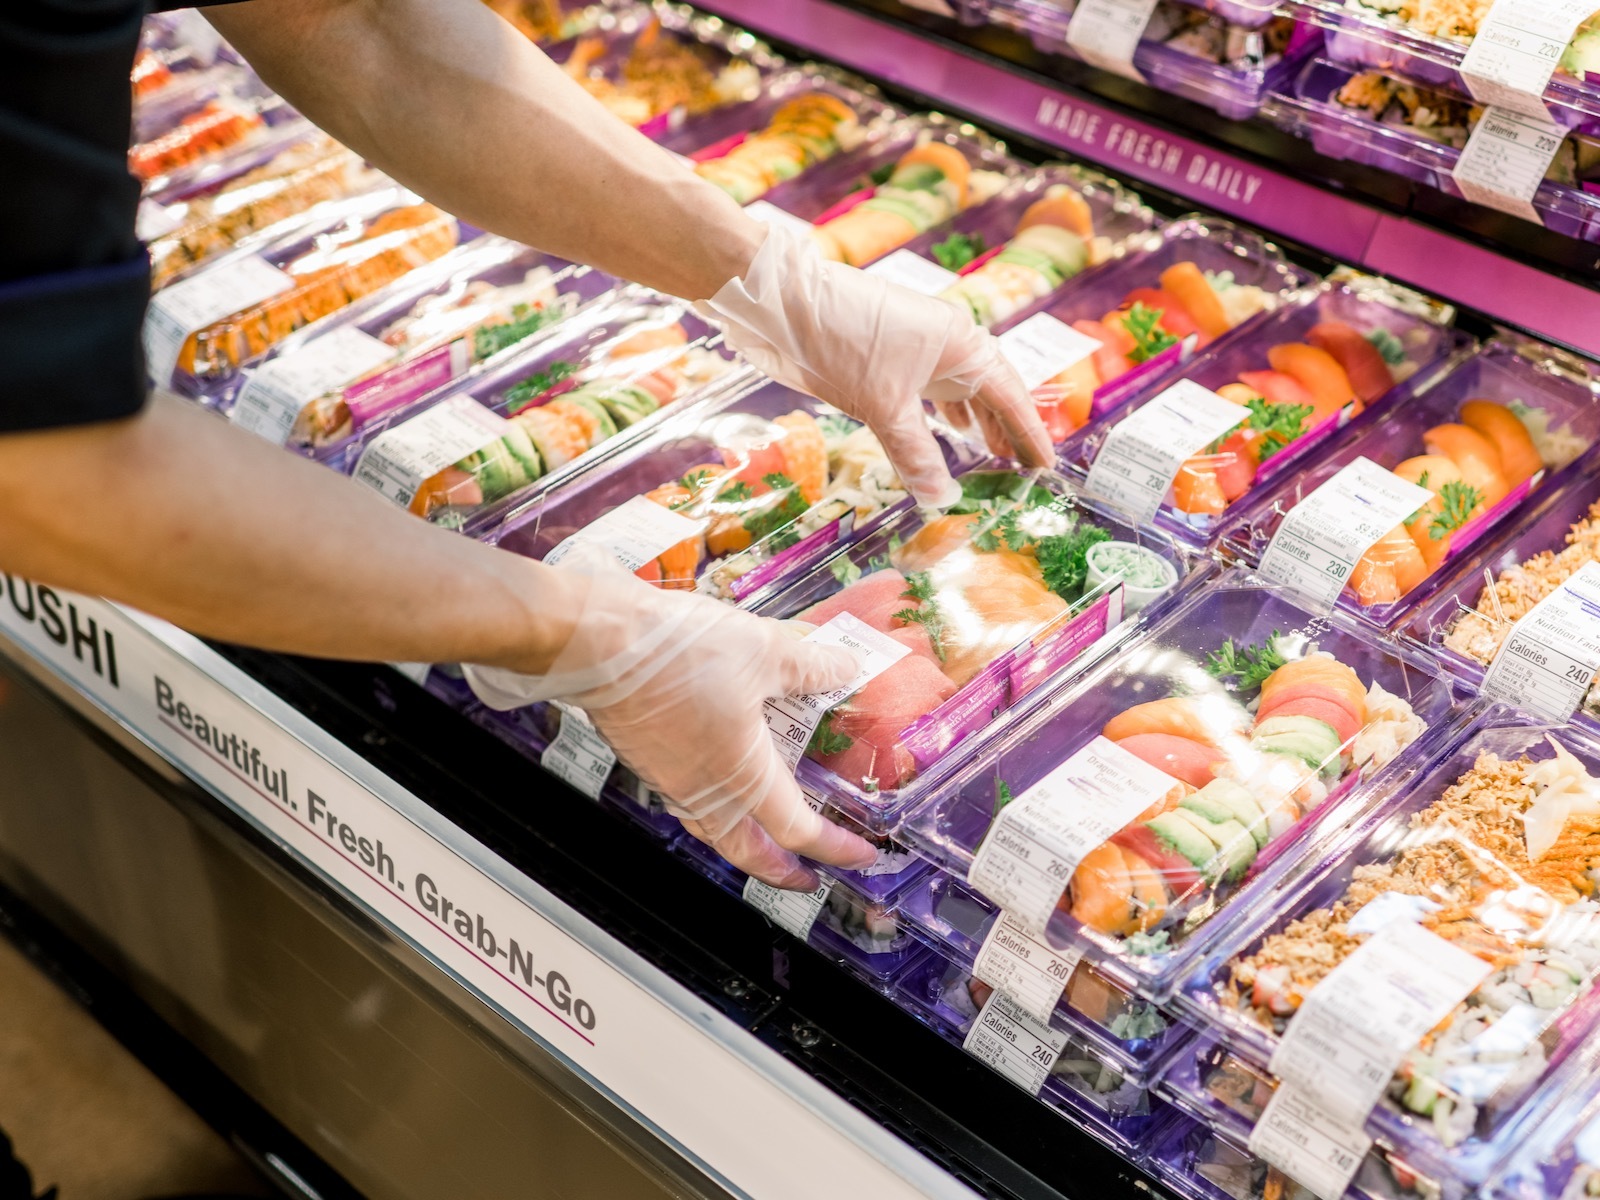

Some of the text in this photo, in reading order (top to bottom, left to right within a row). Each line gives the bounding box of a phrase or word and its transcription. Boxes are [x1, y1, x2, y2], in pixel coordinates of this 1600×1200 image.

[1538, 42, 1560, 58] 220
[1483, 120, 1519, 140] Calories
[1036, 97, 1262, 204] MADE FRESH DAILY
[1146, 474, 1165, 491] 230
[1276, 536, 1311, 561] Calories
[1326, 560, 1347, 578] 230
[0, 572, 119, 689] USHI
[1535, 618, 1576, 641] Nutrition
[1509, 638, 1590, 684] Calories 240
[786, 723, 806, 743] 200
[590, 759, 607, 778] 240
[1087, 755, 1119, 778] Dragon
[154, 674, 596, 1031] Beautiful. Fresh. Grab-N-Go
[995, 830, 1031, 859] Calories
[1046, 860, 1069, 881] 260
[1006, 915, 1025, 932] Serving
[995, 929, 1069, 980] Calories 260
[995, 999, 1012, 1016] Serving
[1031, 1016, 1053, 1035] container
[984, 1012, 1018, 1042] Calories
[1031, 1045, 1053, 1066] 240
[1050, 1039, 1060, 1049] 5oz
[1269, 1113, 1309, 1146] Calories
[1328, 1148, 1354, 1171] 240
